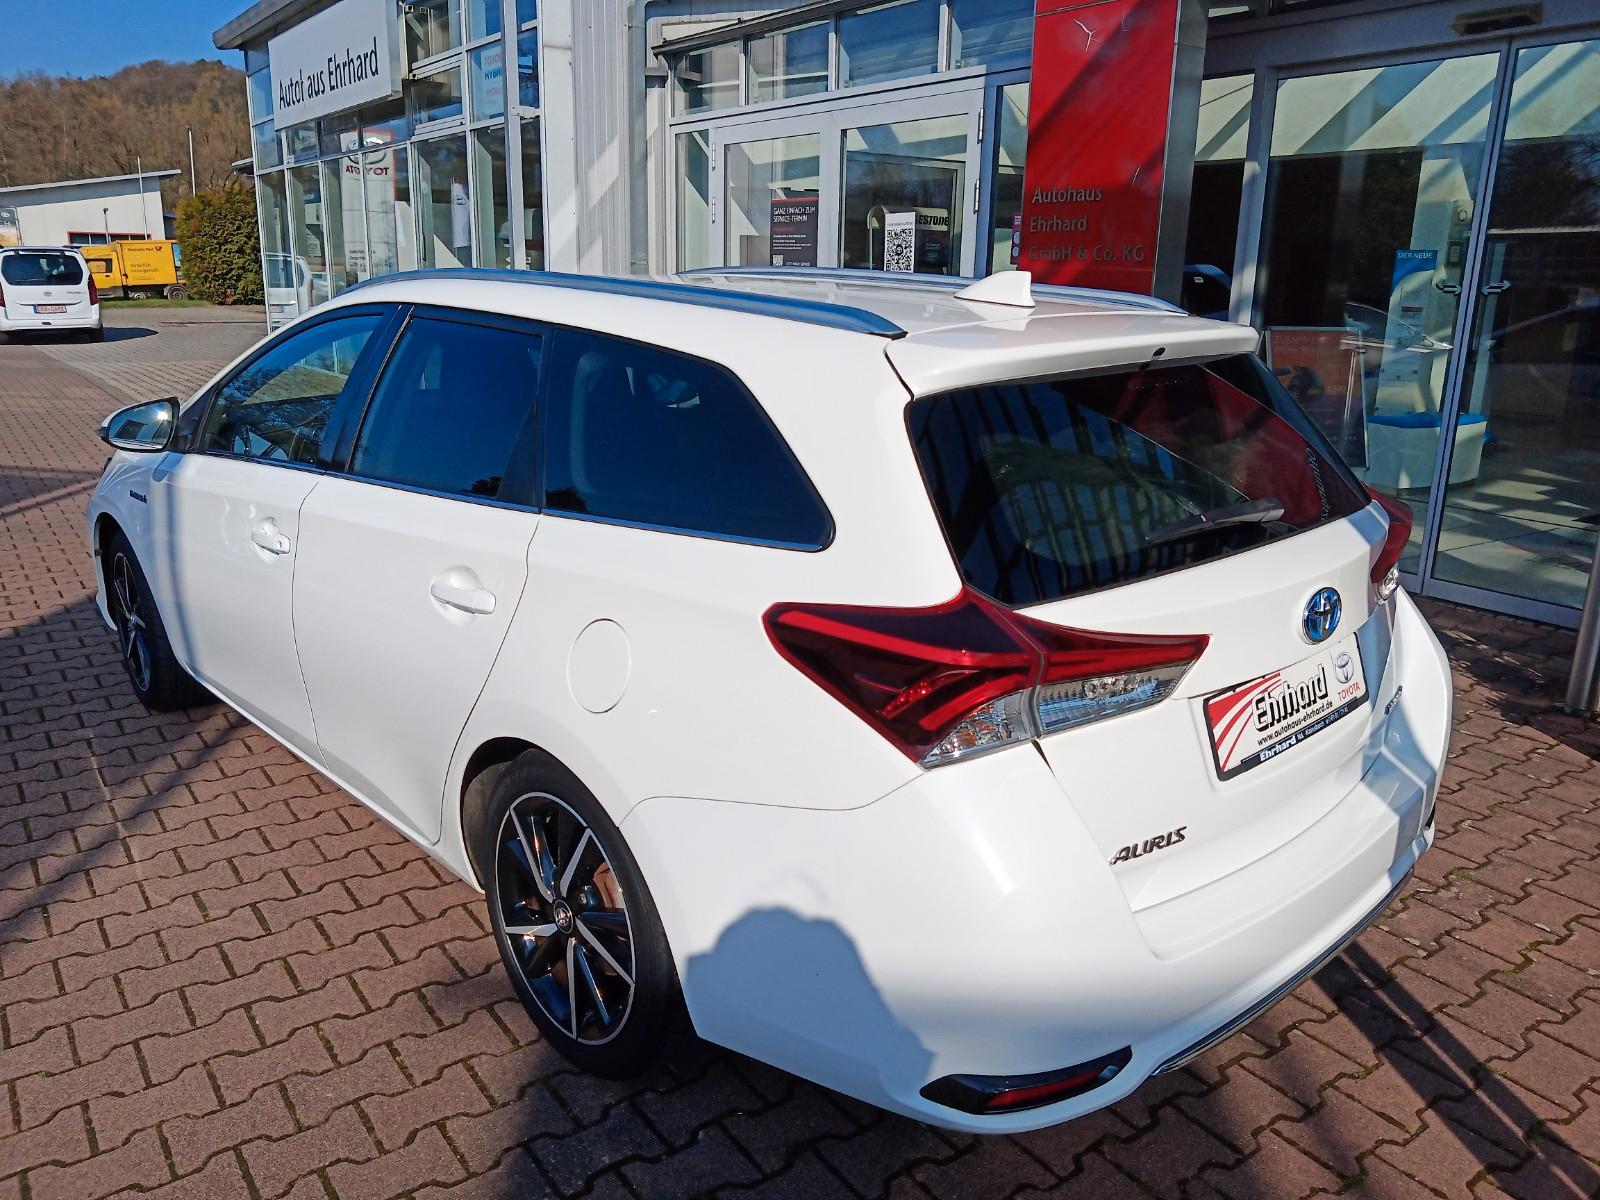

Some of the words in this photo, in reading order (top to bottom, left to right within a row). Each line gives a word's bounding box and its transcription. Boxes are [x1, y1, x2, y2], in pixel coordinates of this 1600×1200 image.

[327, 36, 379, 92] Ehrhard
[1032, 186, 1102, 204] Autohaus
[773, 207, 786, 215] GANZ
[805, 206, 816, 214] ZUM
[1030, 215, 1088, 232] Ehrhard
[1027, 246, 1072, 261] GmbH
[1077, 246, 1089, 260] &
[1093, 246, 1117, 261] Co.
[1122, 245, 1145, 261] KG
[1252, 664, 1329, 733] Ehrhard
[1337, 682, 1361, 701] TOYOTA
[1257, 700, 1334, 747] www.autohaus-ehrhard.de
[1260, 735, 1297, 762] Ehrhard
[1108, 825, 1187, 866] AURIS
